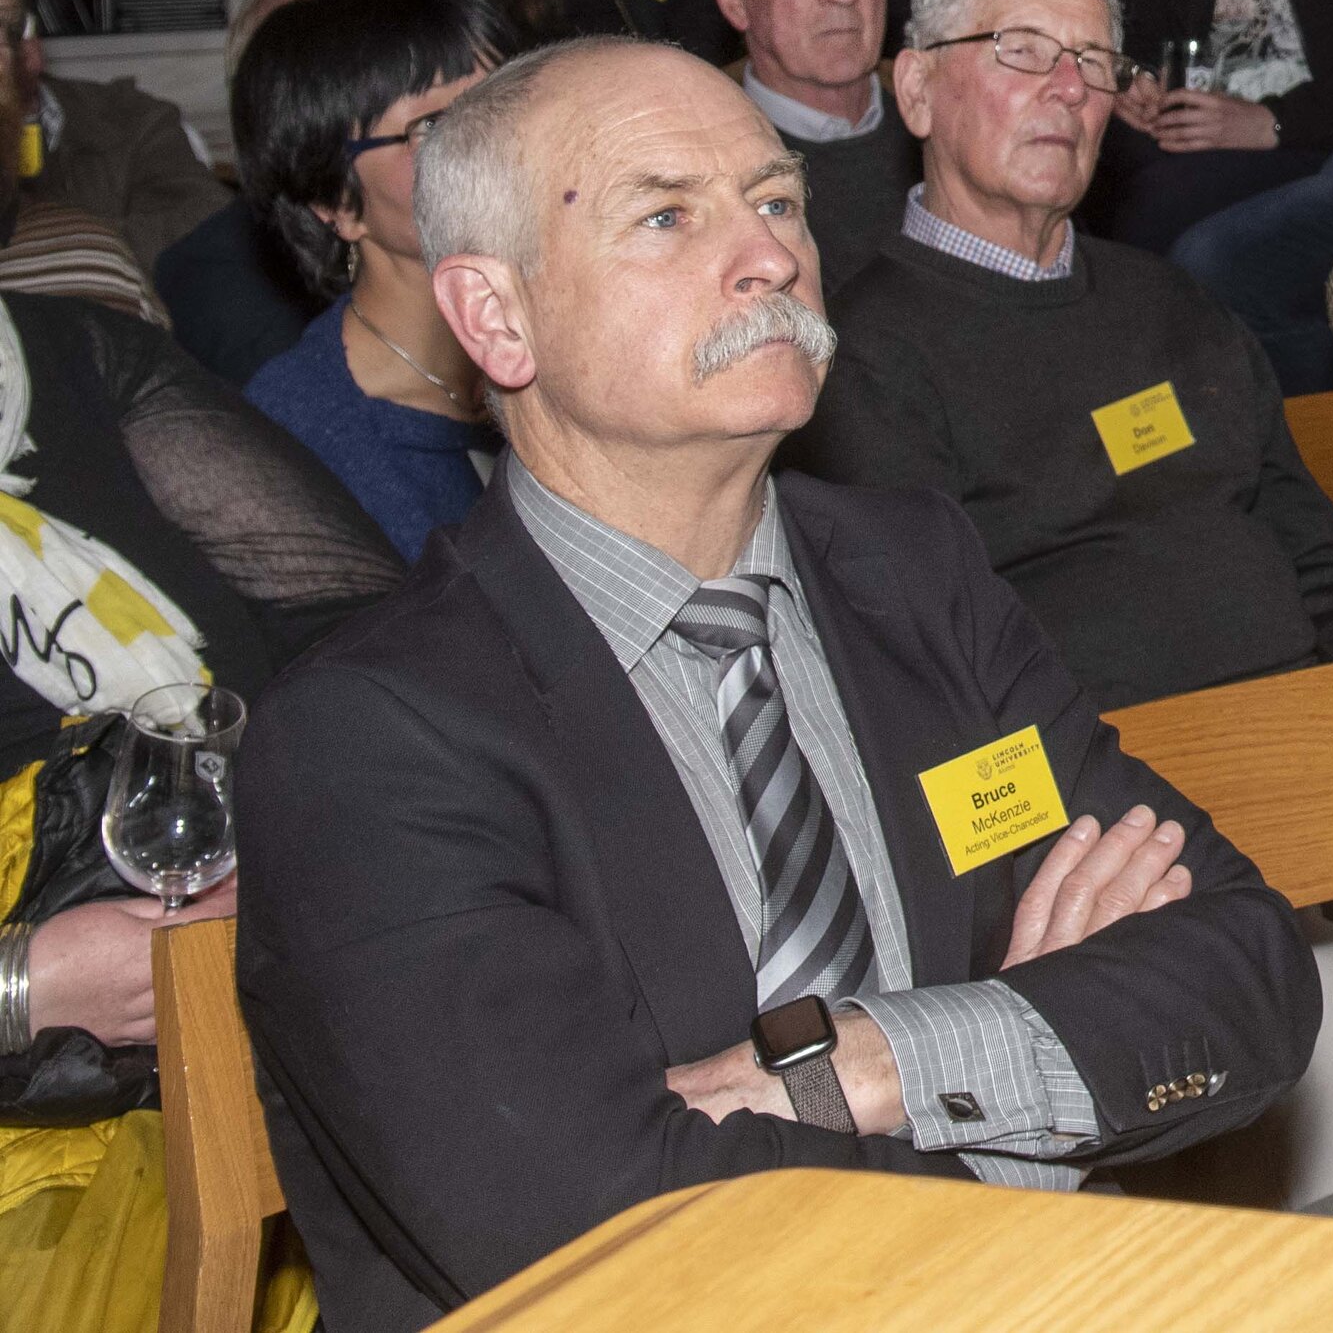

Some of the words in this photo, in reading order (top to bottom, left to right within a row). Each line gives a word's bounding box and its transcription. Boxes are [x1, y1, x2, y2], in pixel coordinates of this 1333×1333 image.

[992, 742, 1025, 761] LINCOLN
[995, 744, 1040, 768] UNIVERSITY
[971, 782, 1017, 810] Bruce
[972, 800, 1032, 835] McKenzie
[965, 838, 990, 856] Acting
[991, 811, 1050, 843] Vice-Chancellor
